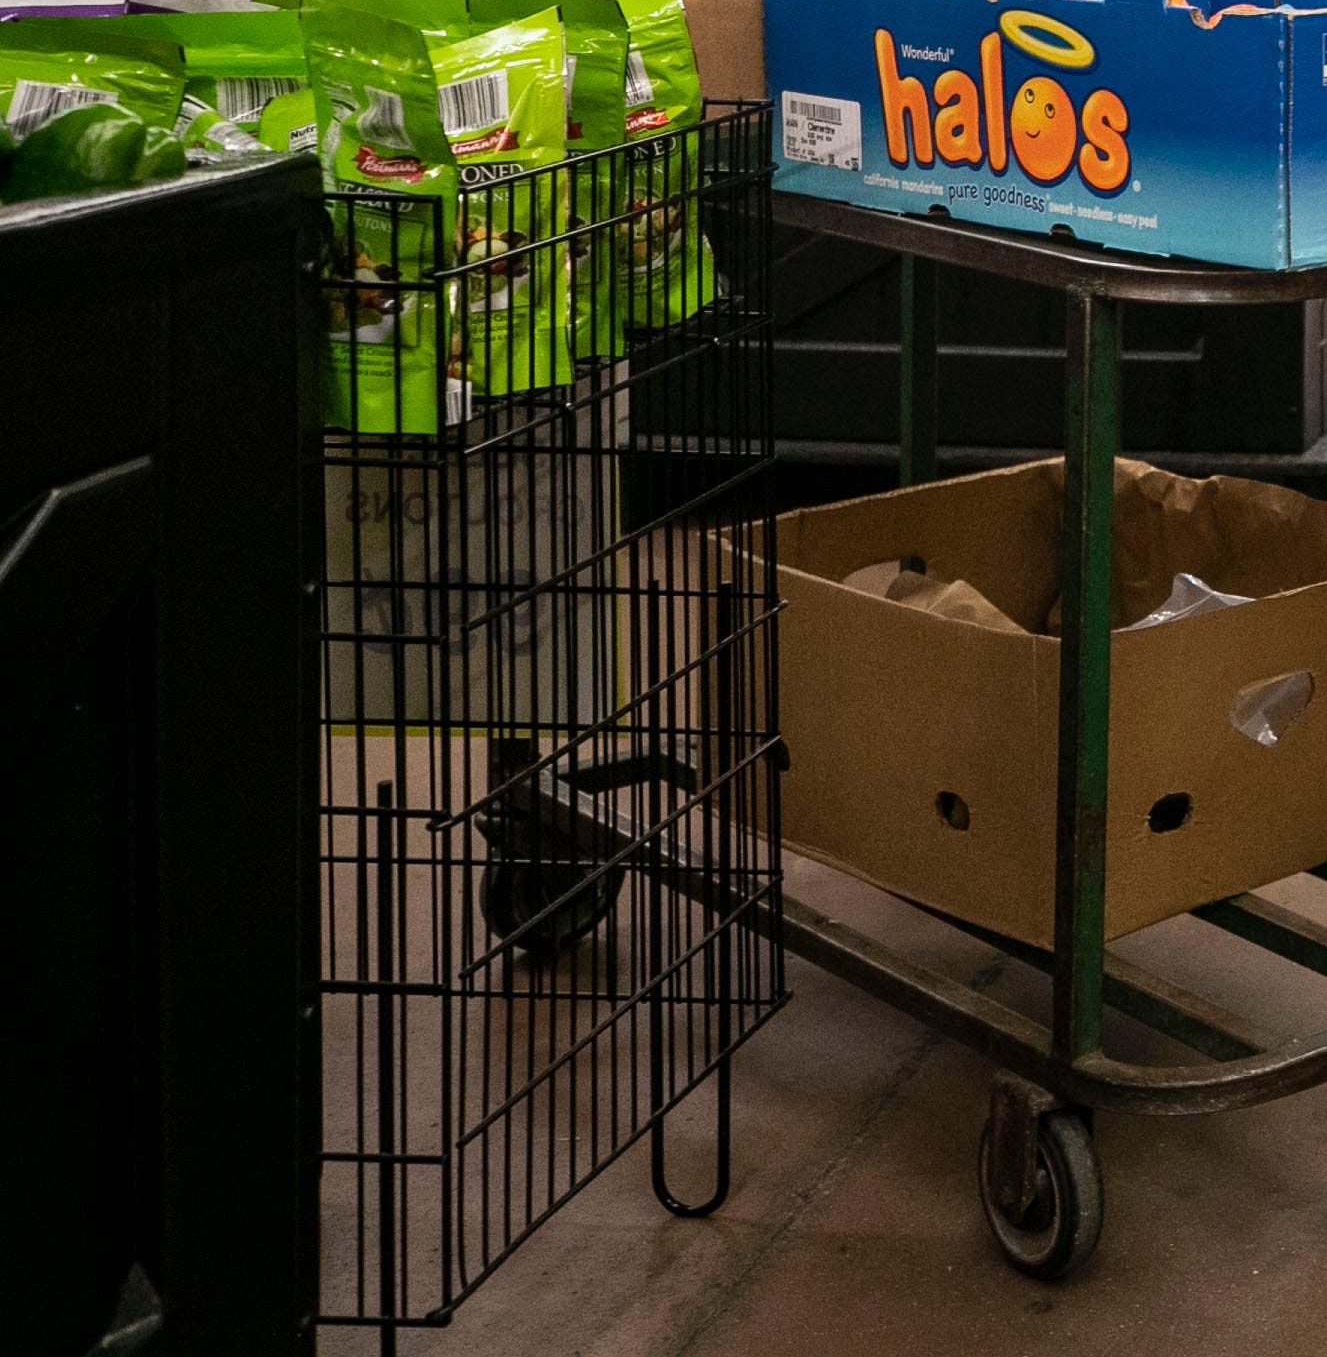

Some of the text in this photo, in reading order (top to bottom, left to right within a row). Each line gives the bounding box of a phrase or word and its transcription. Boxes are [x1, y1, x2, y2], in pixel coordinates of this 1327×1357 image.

[874, 28, 1131, 193] halos
[948, 183, 978, 206] pure
[982, 184, 1045, 214] goodness
